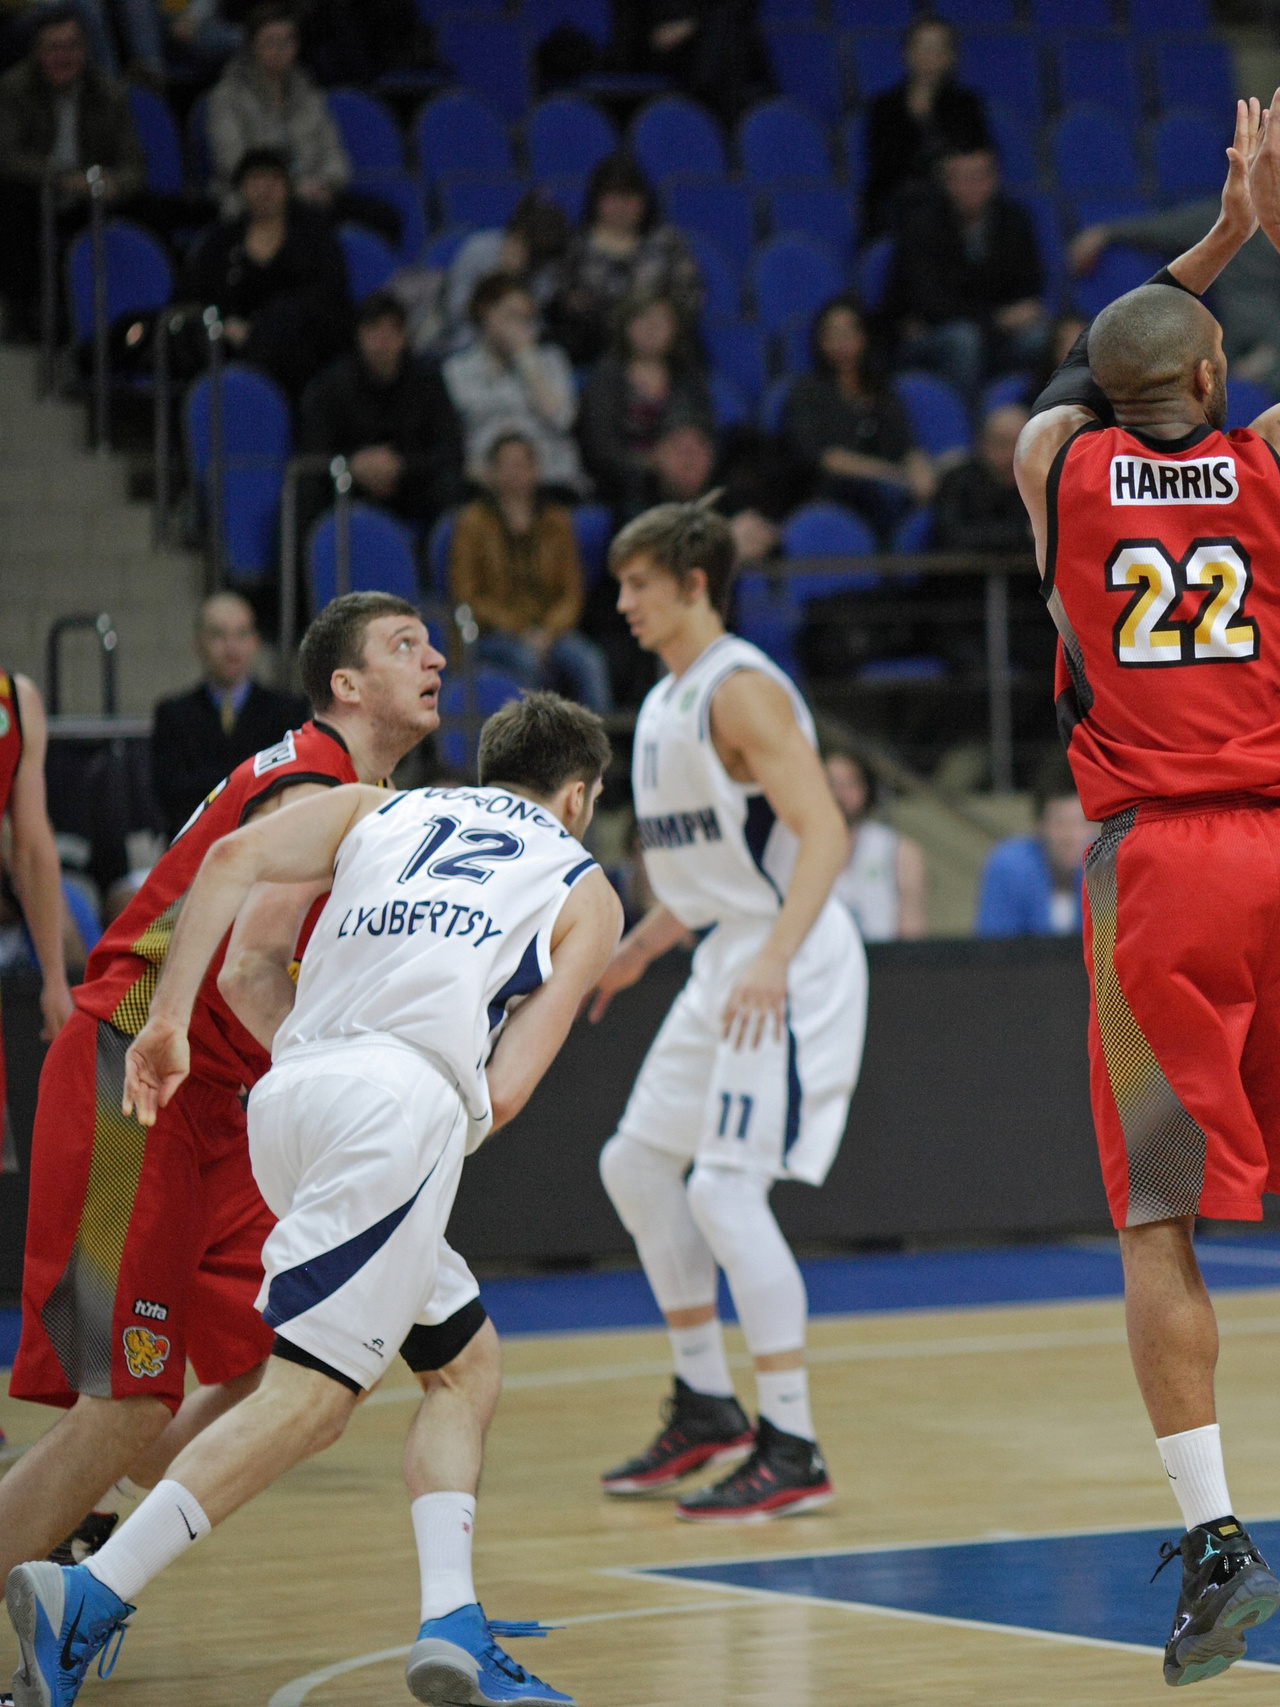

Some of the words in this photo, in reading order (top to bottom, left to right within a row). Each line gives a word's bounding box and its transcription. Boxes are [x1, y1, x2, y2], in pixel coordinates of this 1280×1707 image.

[1115, 461, 1225, 500] HARRIS
[1104, 536, 1260, 669] 22
[397, 814, 525, 885] 12
[337, 901, 503, 948] LYUBERTSY
[717, 1091, 756, 1139] 11
